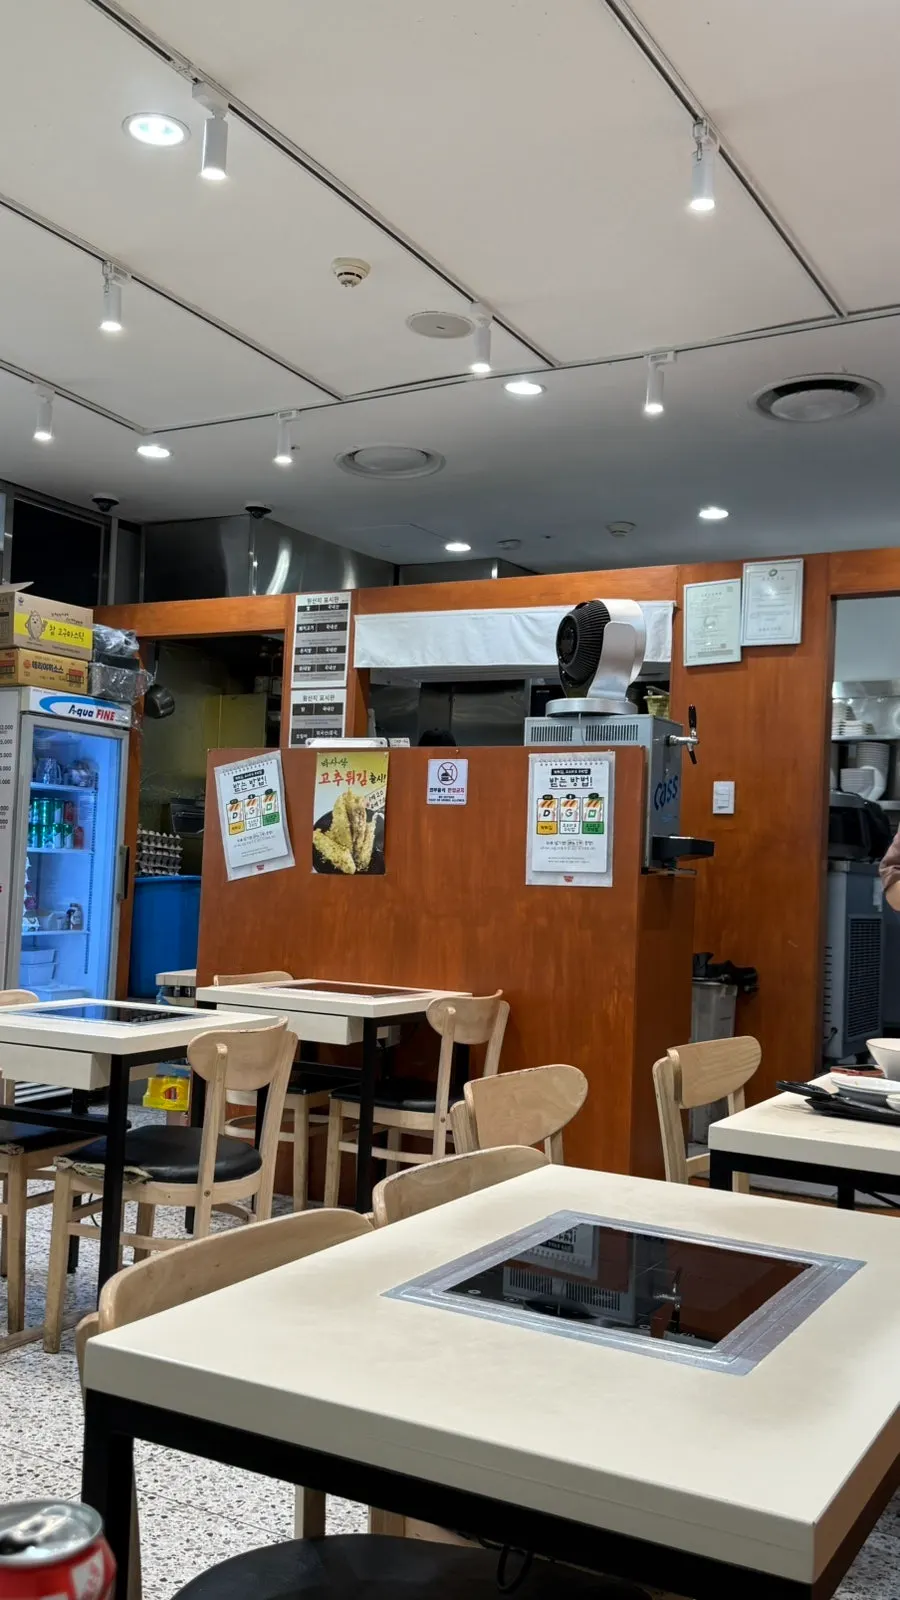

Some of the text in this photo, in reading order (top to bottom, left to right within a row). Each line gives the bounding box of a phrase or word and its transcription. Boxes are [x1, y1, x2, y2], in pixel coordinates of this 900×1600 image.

[68, 704, 93, 718] Aqua
[96, 708, 116, 721] FINE
[318, 770, 367, 787] 고추튀김
[549, 776, 593, 788] 받는 방법!
